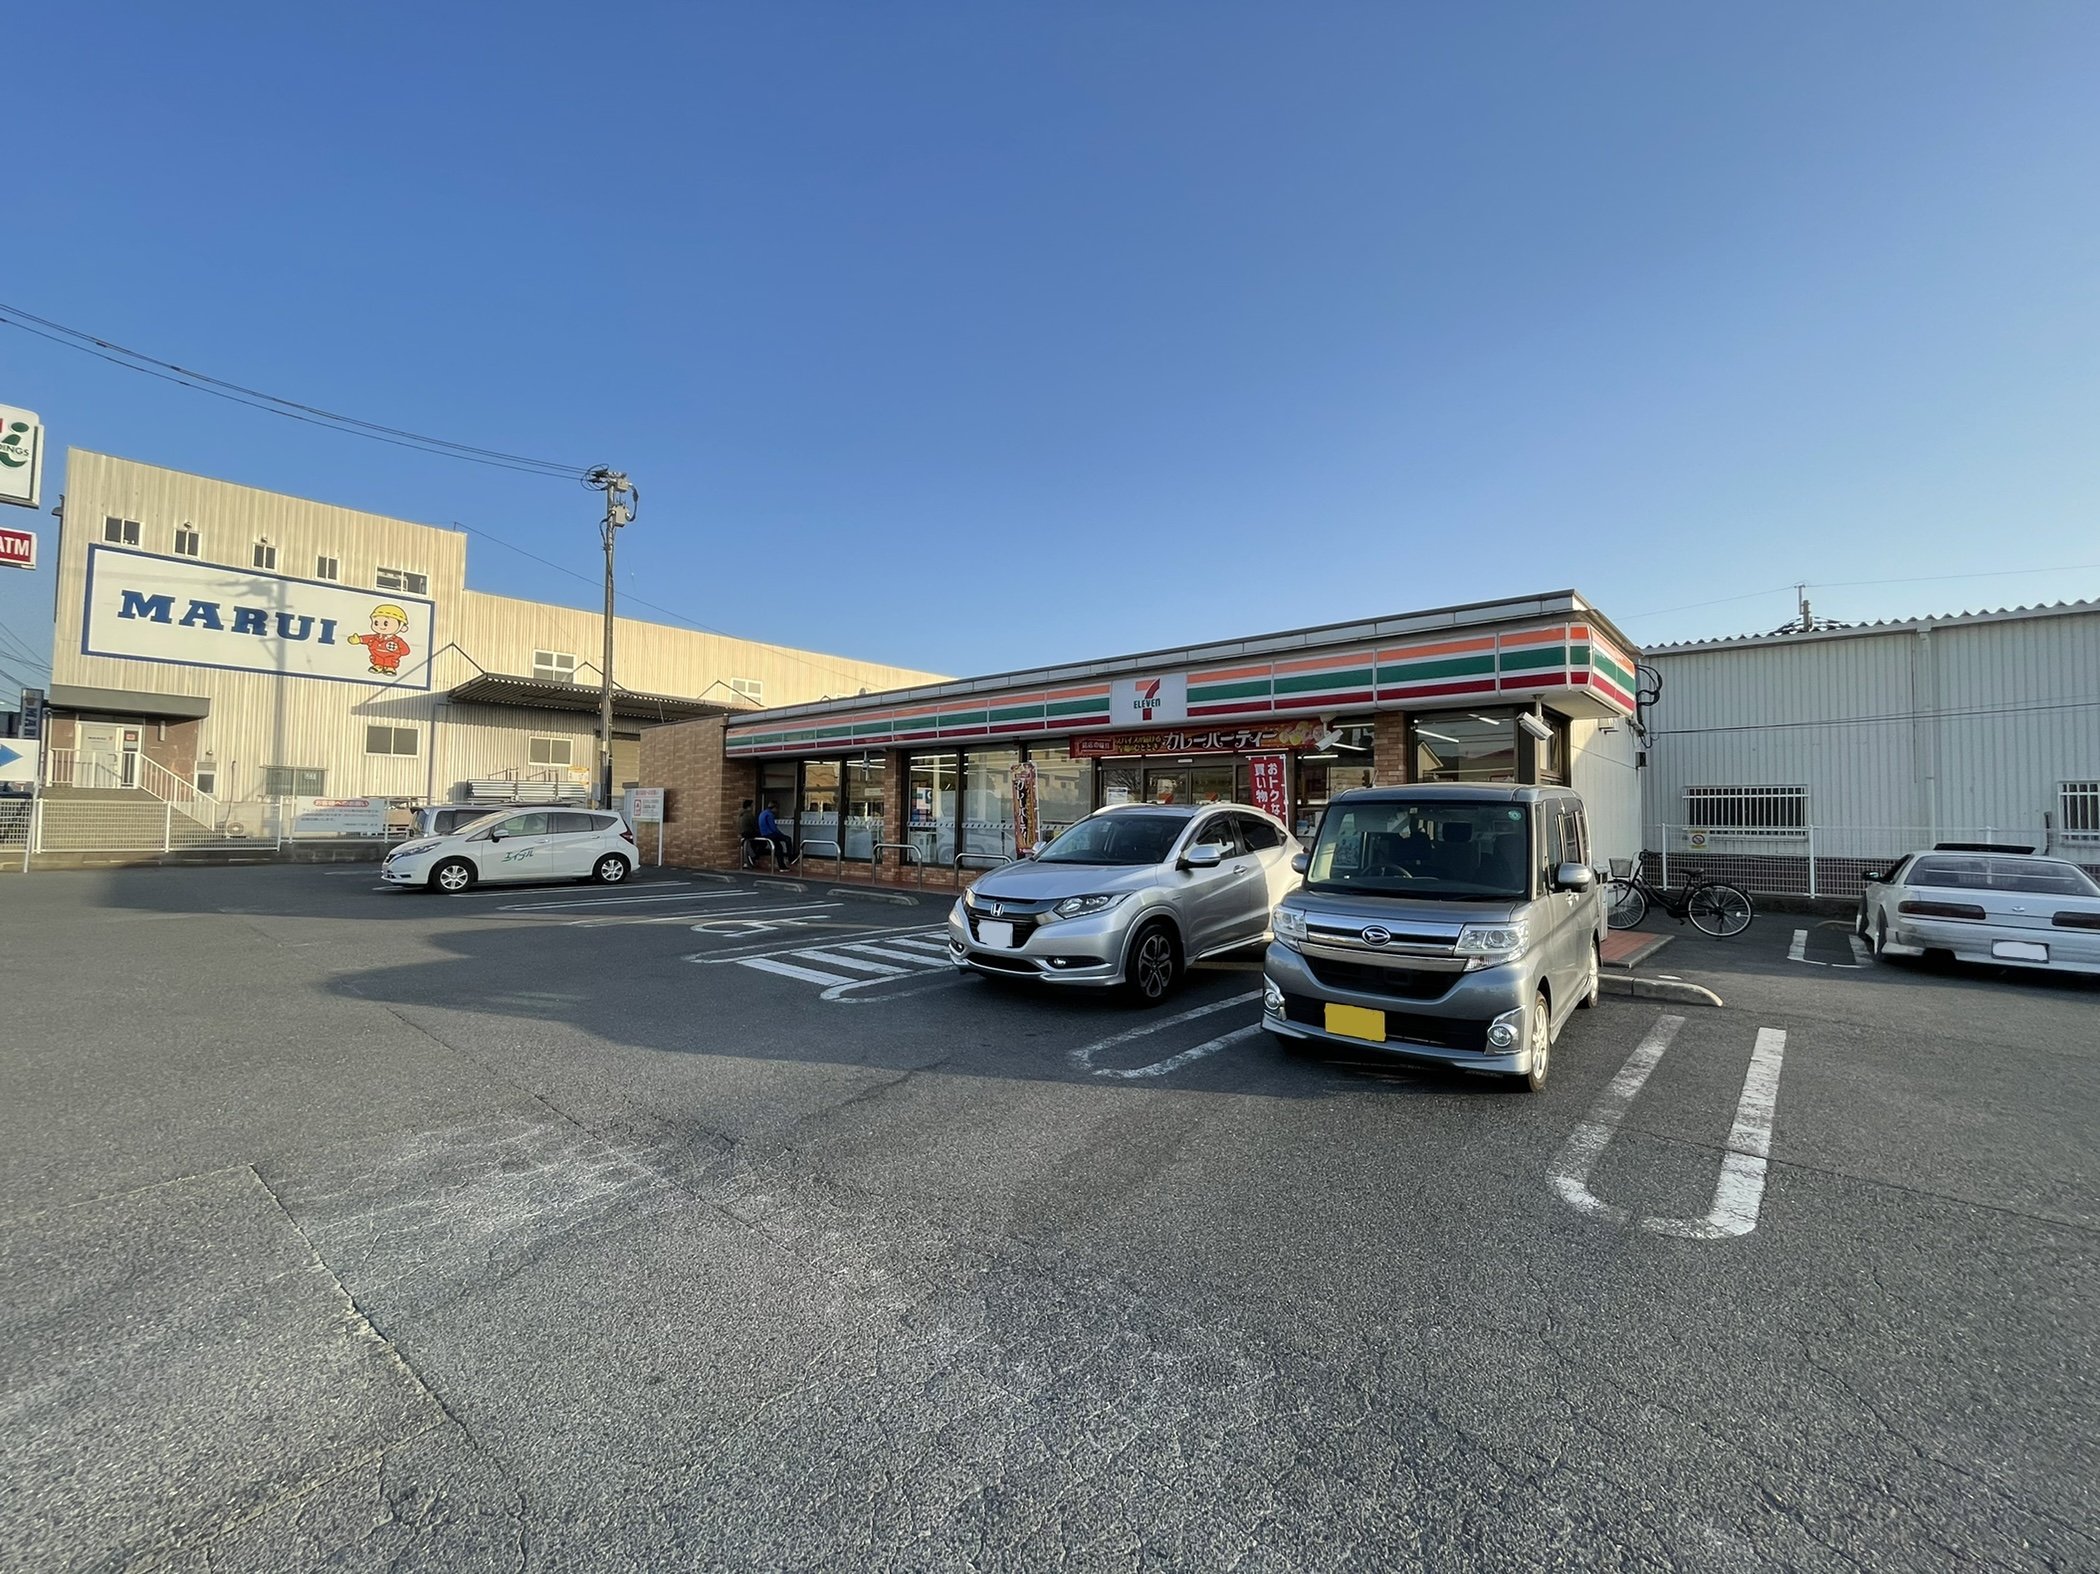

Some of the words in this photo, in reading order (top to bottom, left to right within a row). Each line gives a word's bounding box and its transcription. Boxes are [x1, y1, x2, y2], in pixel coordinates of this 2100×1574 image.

[117, 589, 338, 645] MARUI
[1163, 730, 1279, 751] カレーパーティー
[1267, 762, 1281, 815] おトクな
